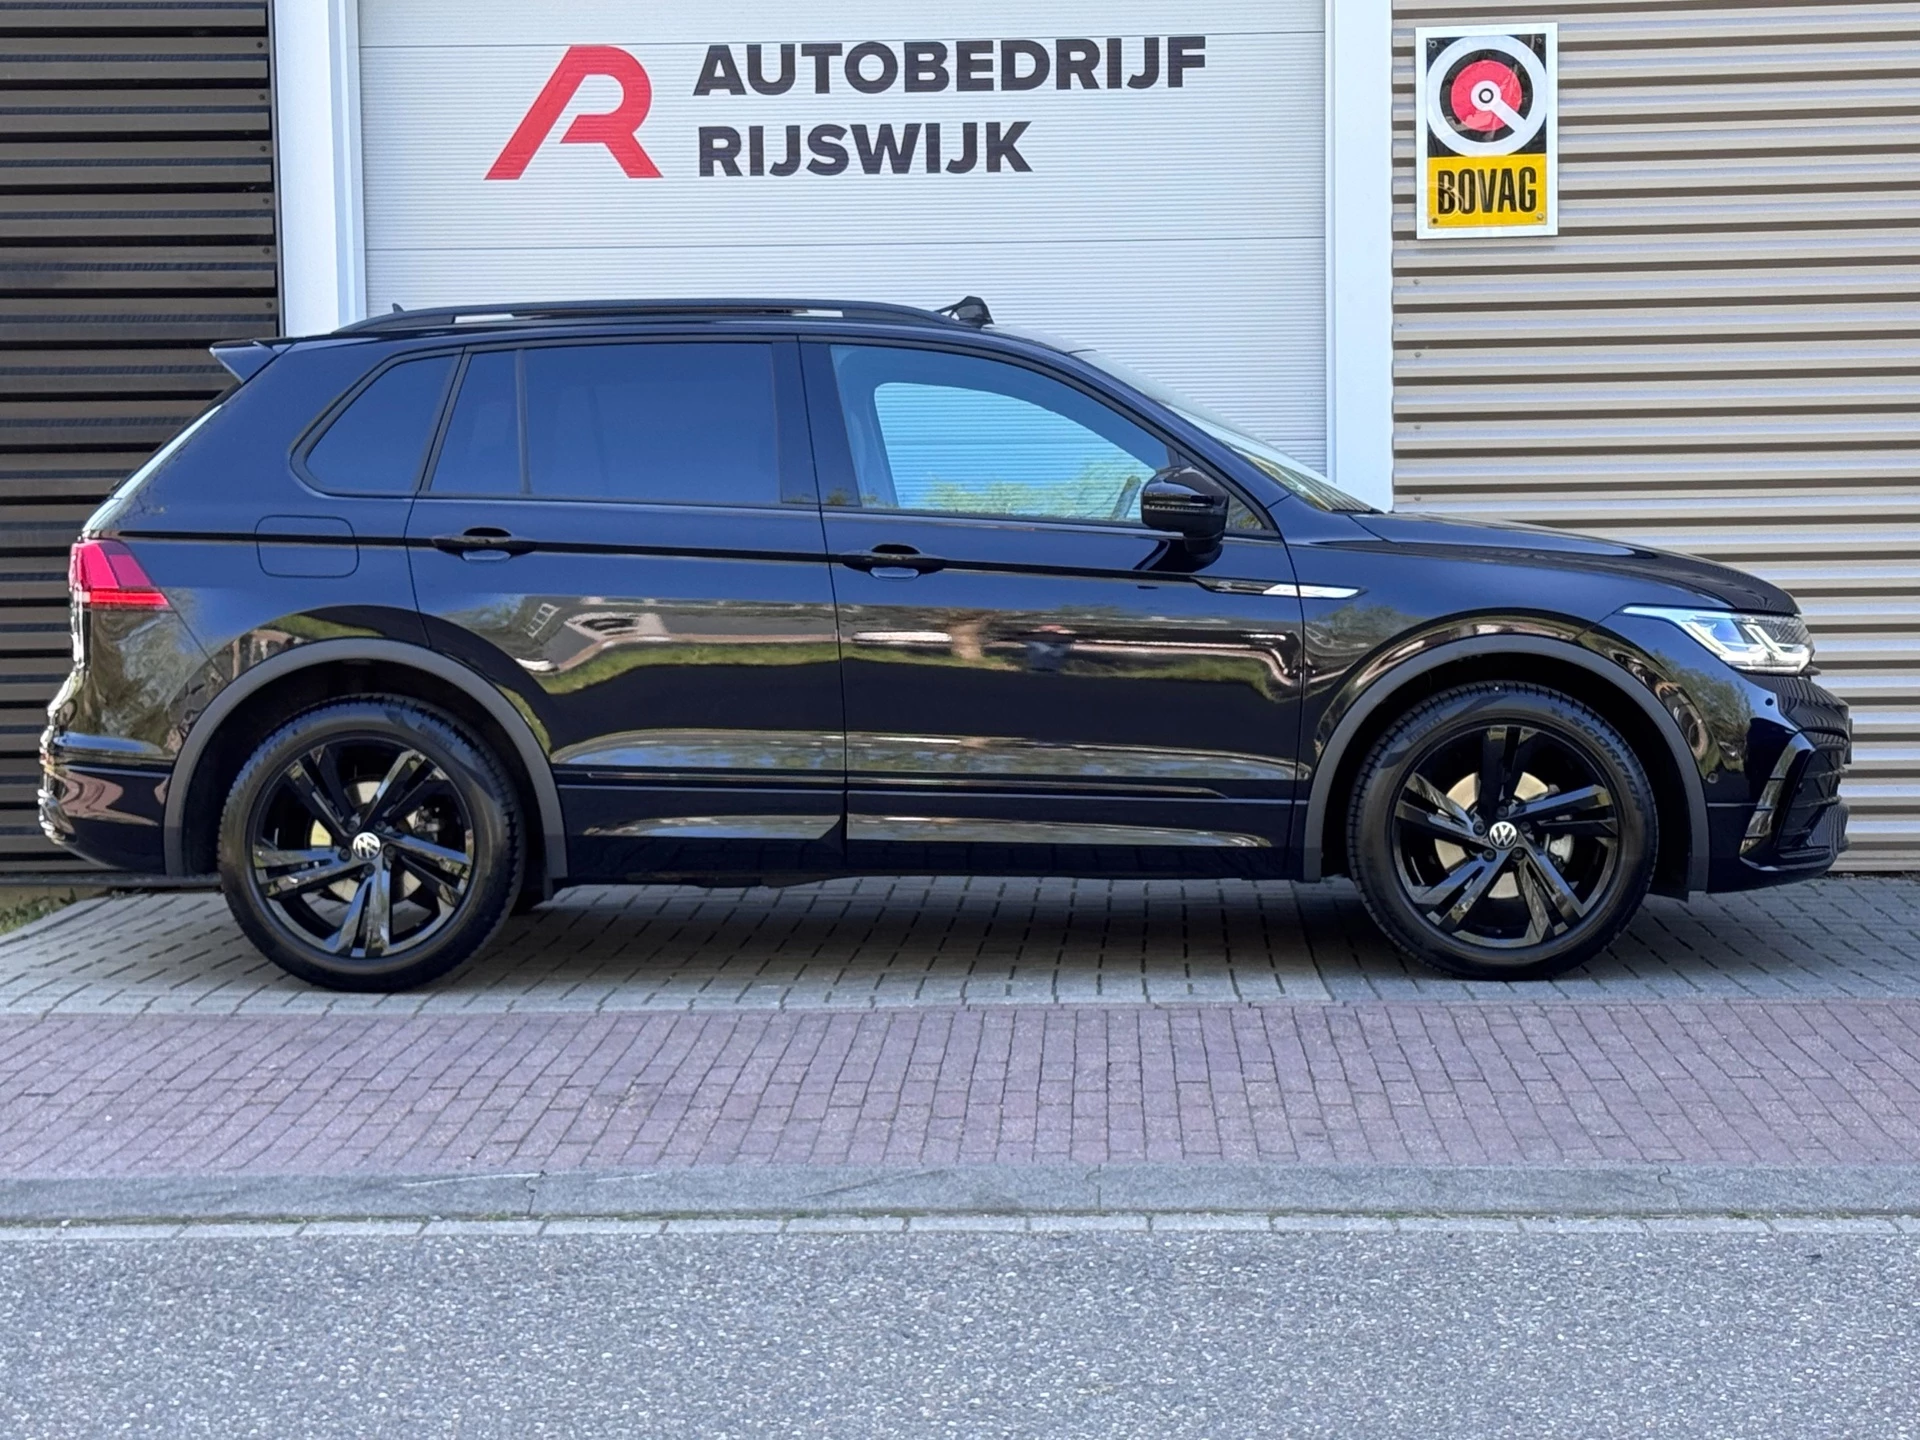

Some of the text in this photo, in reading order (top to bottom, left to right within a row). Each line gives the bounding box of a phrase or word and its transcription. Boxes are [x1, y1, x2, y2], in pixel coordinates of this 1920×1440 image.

[693, 36, 1206, 96] AUTOBEDRIJF
[698, 121, 1033, 177] RIJSWIJK
[1437, 166, 1537, 215] BOVAG
[1489, 821, 1517, 848] VW
